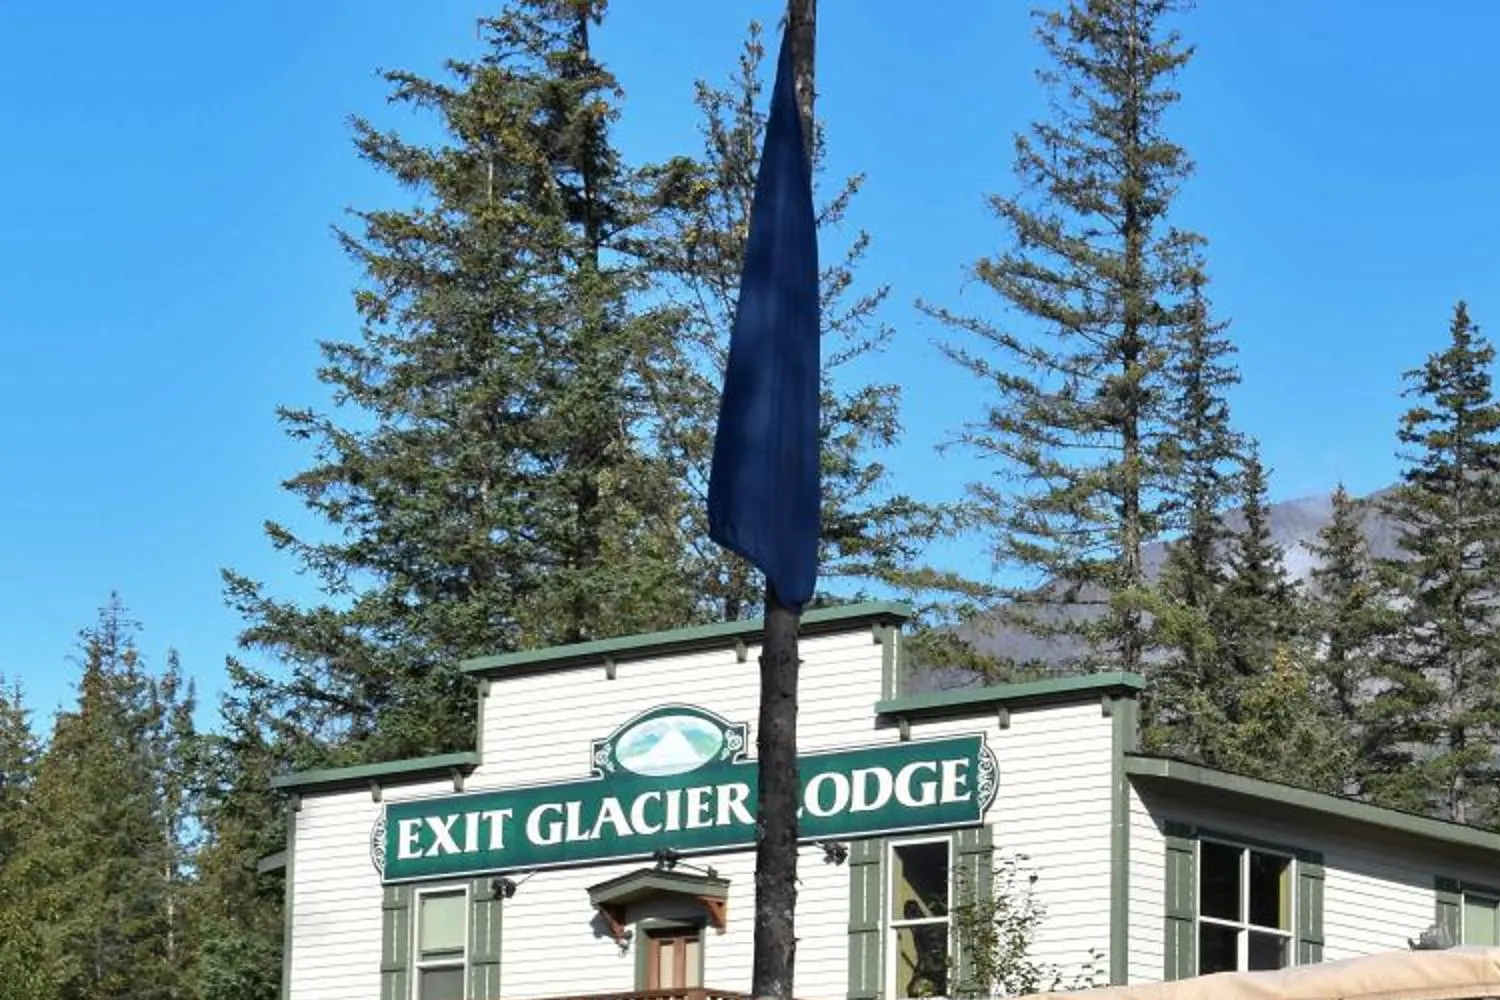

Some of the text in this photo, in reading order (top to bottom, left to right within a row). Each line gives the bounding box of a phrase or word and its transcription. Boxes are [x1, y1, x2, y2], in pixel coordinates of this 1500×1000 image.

[397, 758, 972, 860] EXIT GLACIER ODGE
